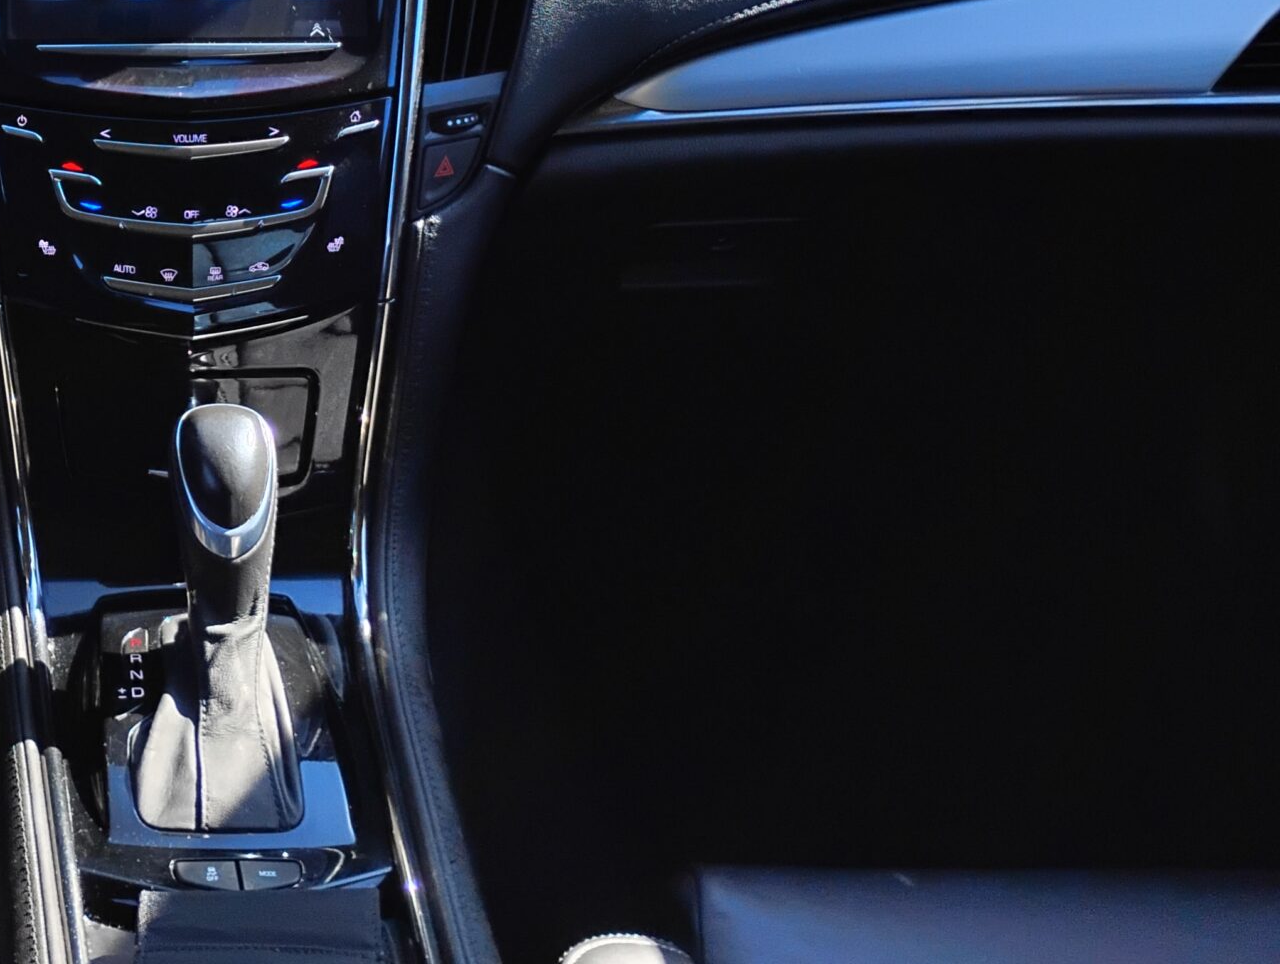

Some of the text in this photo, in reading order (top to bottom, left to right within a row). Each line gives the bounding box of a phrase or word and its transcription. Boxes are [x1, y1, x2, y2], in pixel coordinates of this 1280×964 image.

[173, 134, 208, 144] VOLUME
[183, 210, 200, 219] OFF
[113, 263, 136, 274] AUTO
[129, 653, 143, 664] R
[129, 669, 144, 681] N
[131, 686, 145, 698] D
